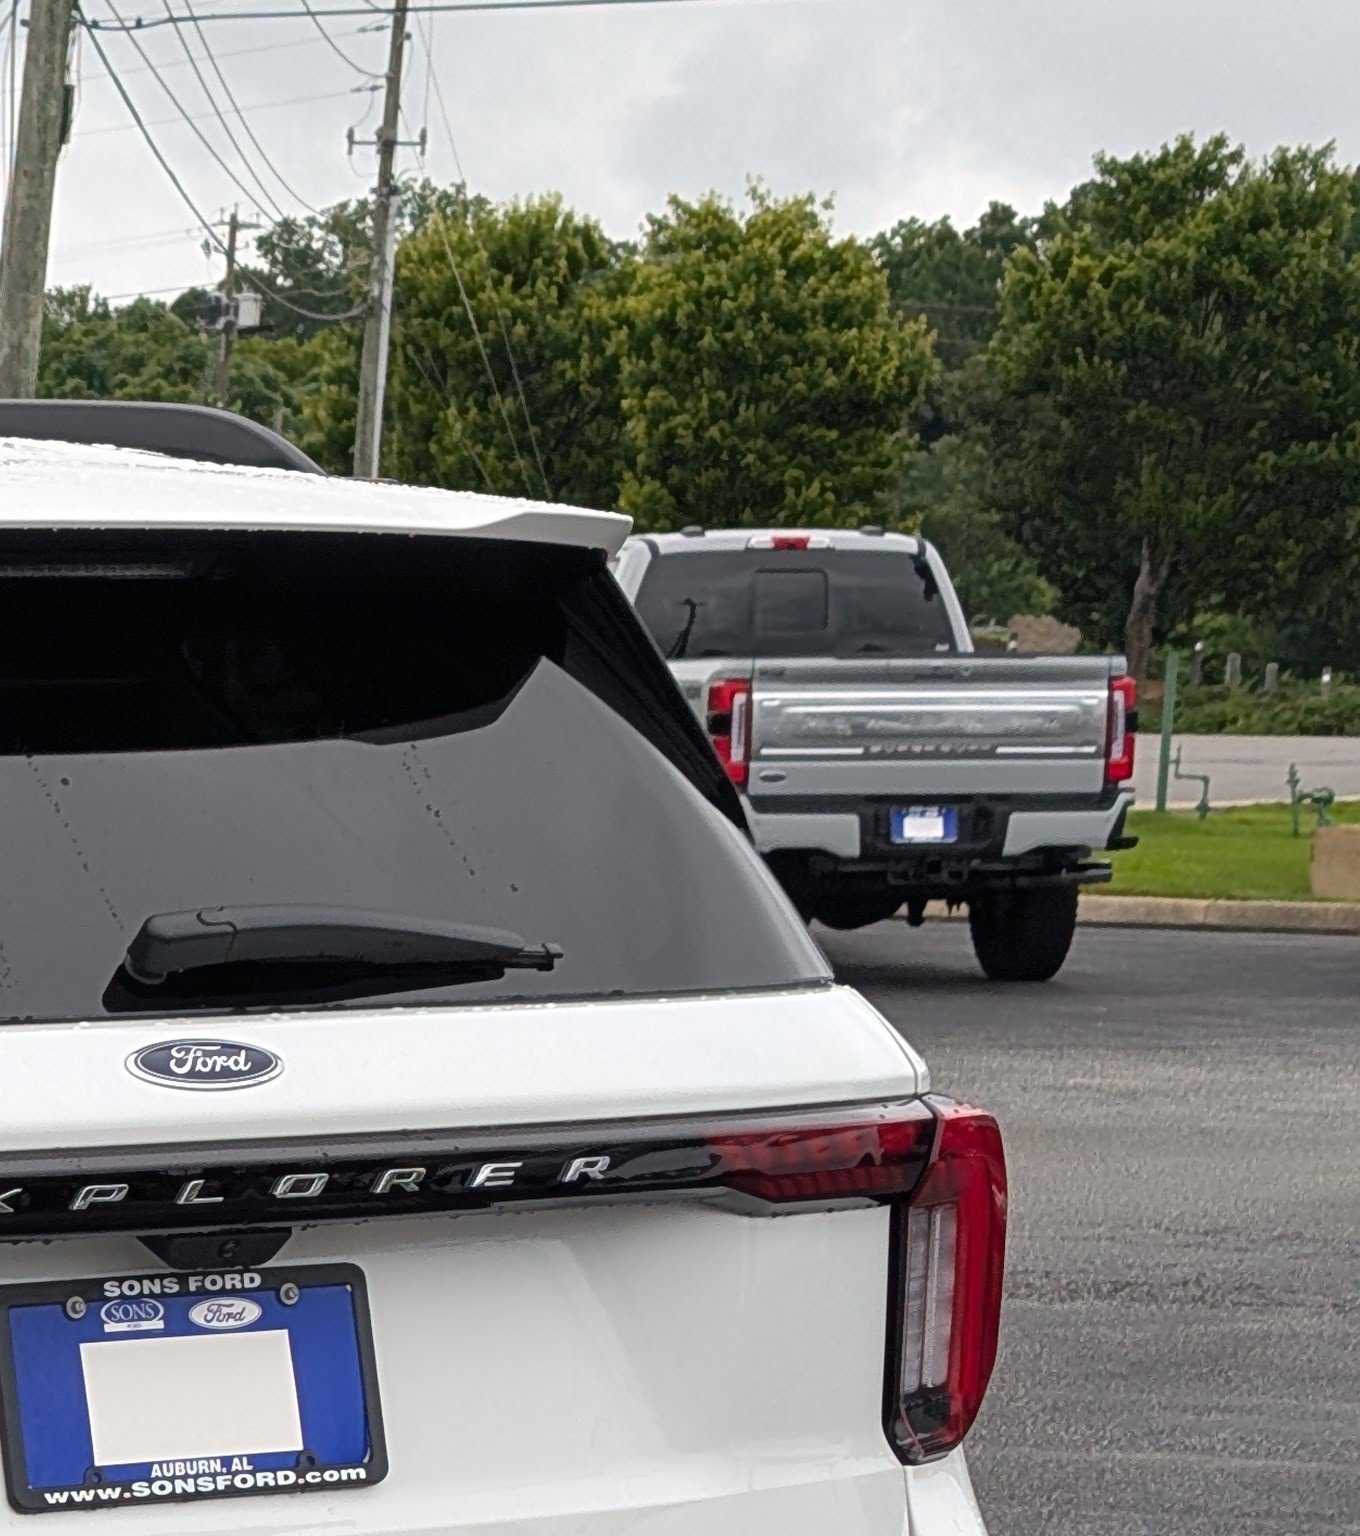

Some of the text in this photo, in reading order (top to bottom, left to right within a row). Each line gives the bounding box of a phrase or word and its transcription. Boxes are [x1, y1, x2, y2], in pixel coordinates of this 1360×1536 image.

[169, 1045, 251, 1074] Ford
[103, 1273, 262, 1297] SONS FORD
[110, 1303, 155, 1321] SONS
[203, 1303, 246, 1323] Ford
[231, 1457, 253, 1471] AL
[44, 1467, 366, 1505] www.SONSFORD.com
